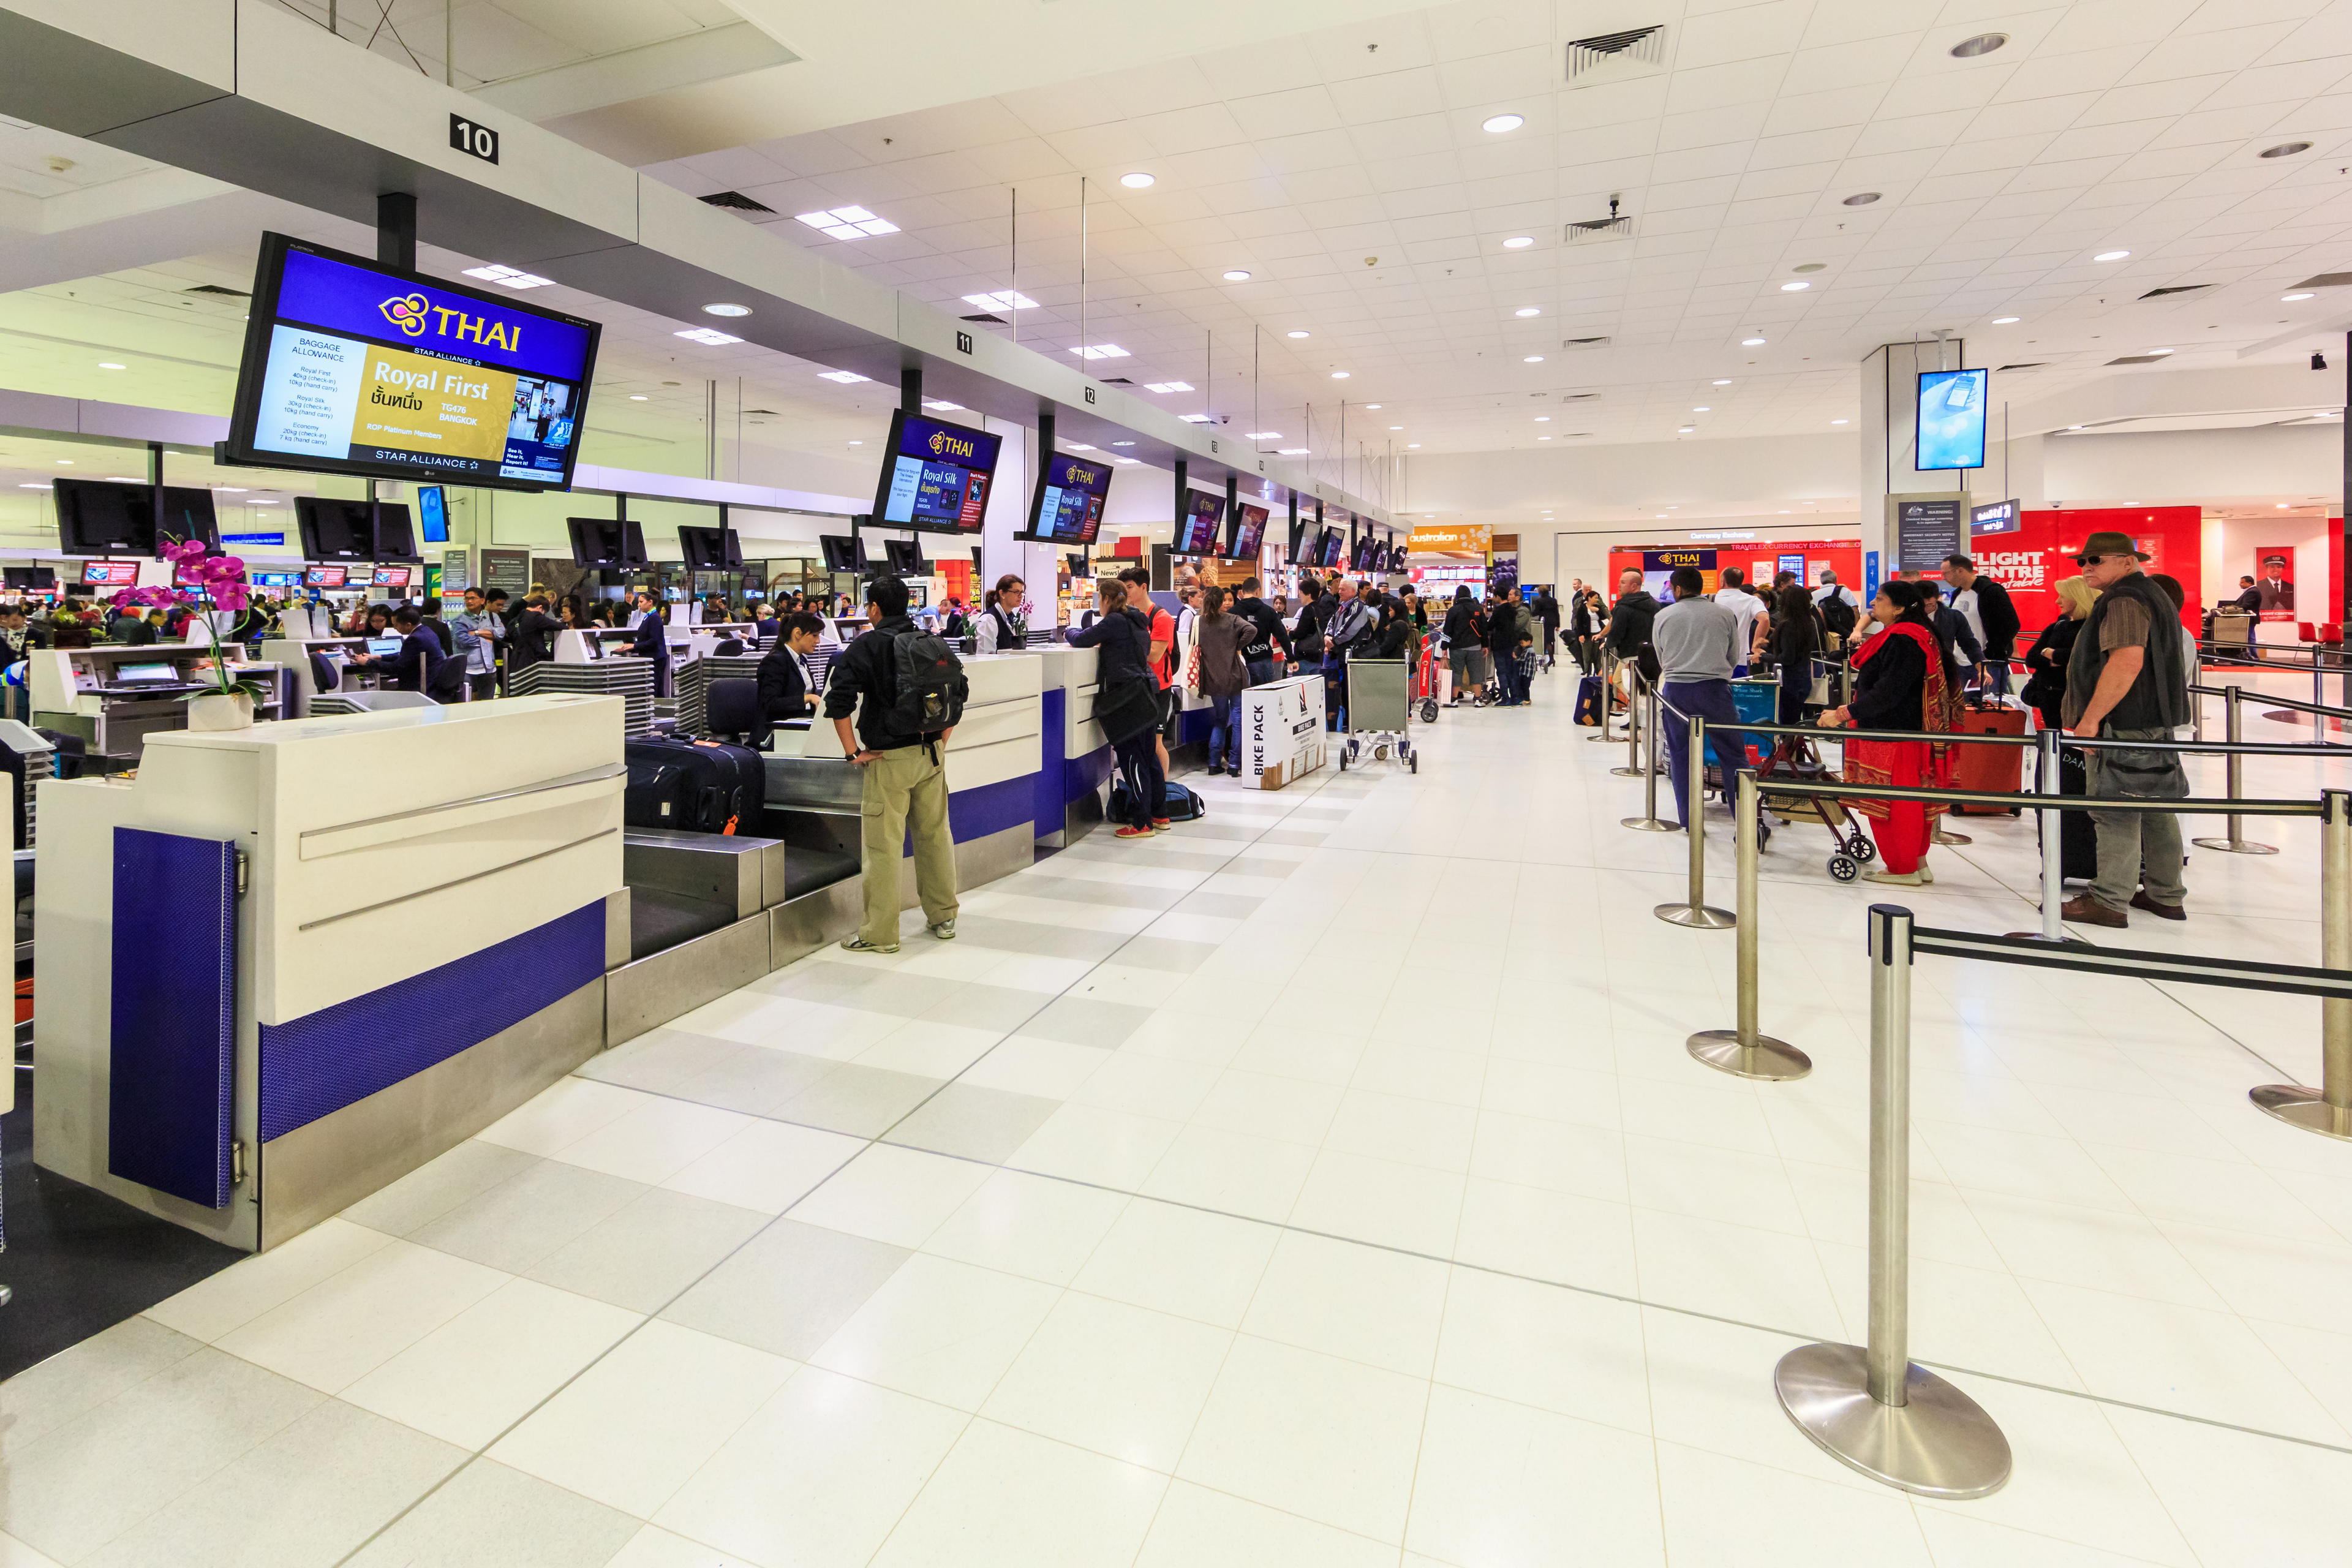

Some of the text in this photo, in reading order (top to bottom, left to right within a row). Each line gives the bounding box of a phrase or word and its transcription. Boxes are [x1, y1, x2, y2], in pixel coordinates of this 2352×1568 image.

[456, 122, 492, 157] 10
[432, 305, 521, 352] THAI
[300, 338, 341, 352] BAGGAGE
[960, 334, 970, 352] 11
[292, 347, 345, 362] ALLOWANCE
[414, 347, 473, 365] STAR ALLIANCE
[301, 366, 317, 375] Royal
[293, 372, 336, 385] 40kg (check-in)
[374, 361, 489, 400] Royal First
[1086, 388, 1094, 402] 12
[303, 402, 331, 412] (check-in)
[441, 402, 467, 414] TG476
[293, 422, 319, 431] Economy
[439, 413, 478, 426] BANGKOK
[298, 430, 326, 439] (check-in)
[383, 425, 412, 435] Platinum
[414, 430, 442, 440] Members
[946, 436, 973, 458] THAI
[1213, 442, 1218, 452] 13
[375, 450, 467, 468] STAR ALLIANCE
[923, 469, 957, 485] Royal Silk
[1076, 469, 1095, 484] THAI
[1061, 495, 1074, 506] Royal
[1074, 496, 1083, 507] Silk
[1205, 501, 1215, 512] THAI
[1409, 532, 1458, 542] australian
[1672, 554, 1700, 563] THAI
[1254, 705, 1264, 775] BIKE PACK
[2063, 753, 2086, 771] DAN
